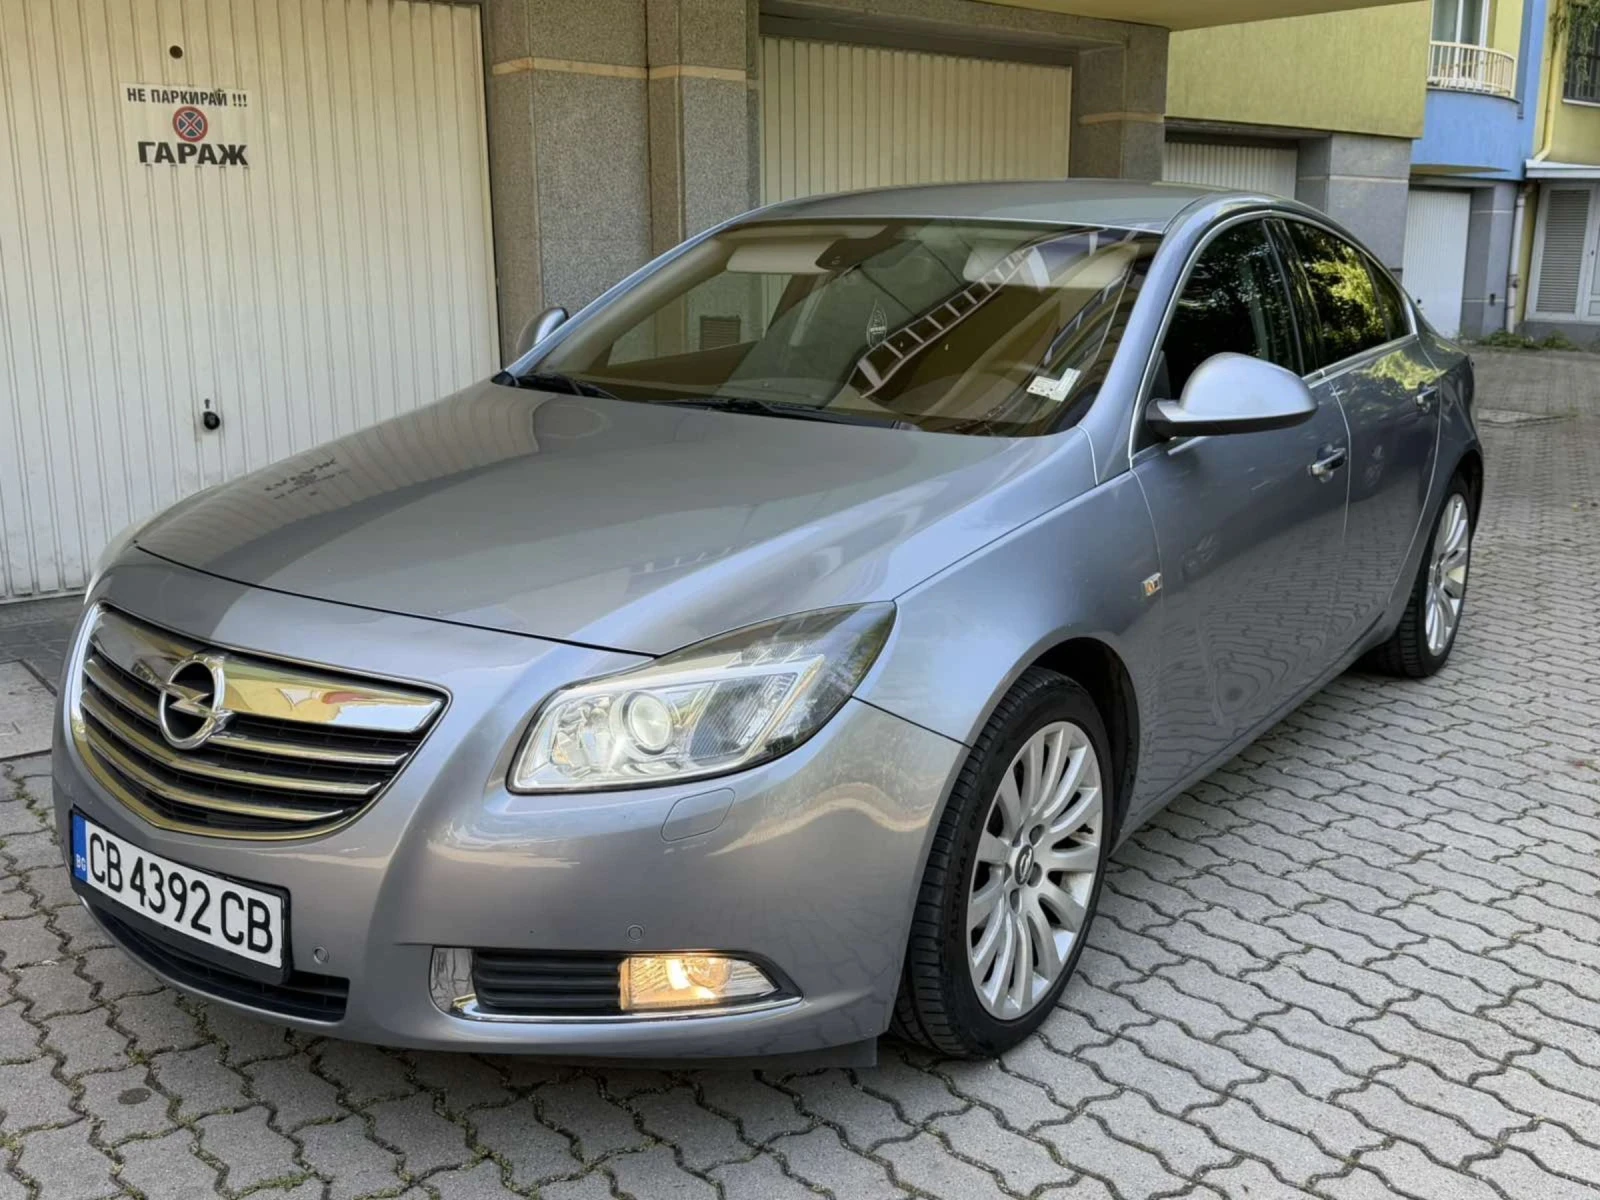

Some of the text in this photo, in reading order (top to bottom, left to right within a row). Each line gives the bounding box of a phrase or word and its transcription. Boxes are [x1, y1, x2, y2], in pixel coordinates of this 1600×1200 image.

[127, 87, 146, 103] НЕ
[151, 88, 228, 107] ПАРКИРАЙ
[137, 141, 249, 166] ГАРАЖ
[76, 853, 87, 871] BG
